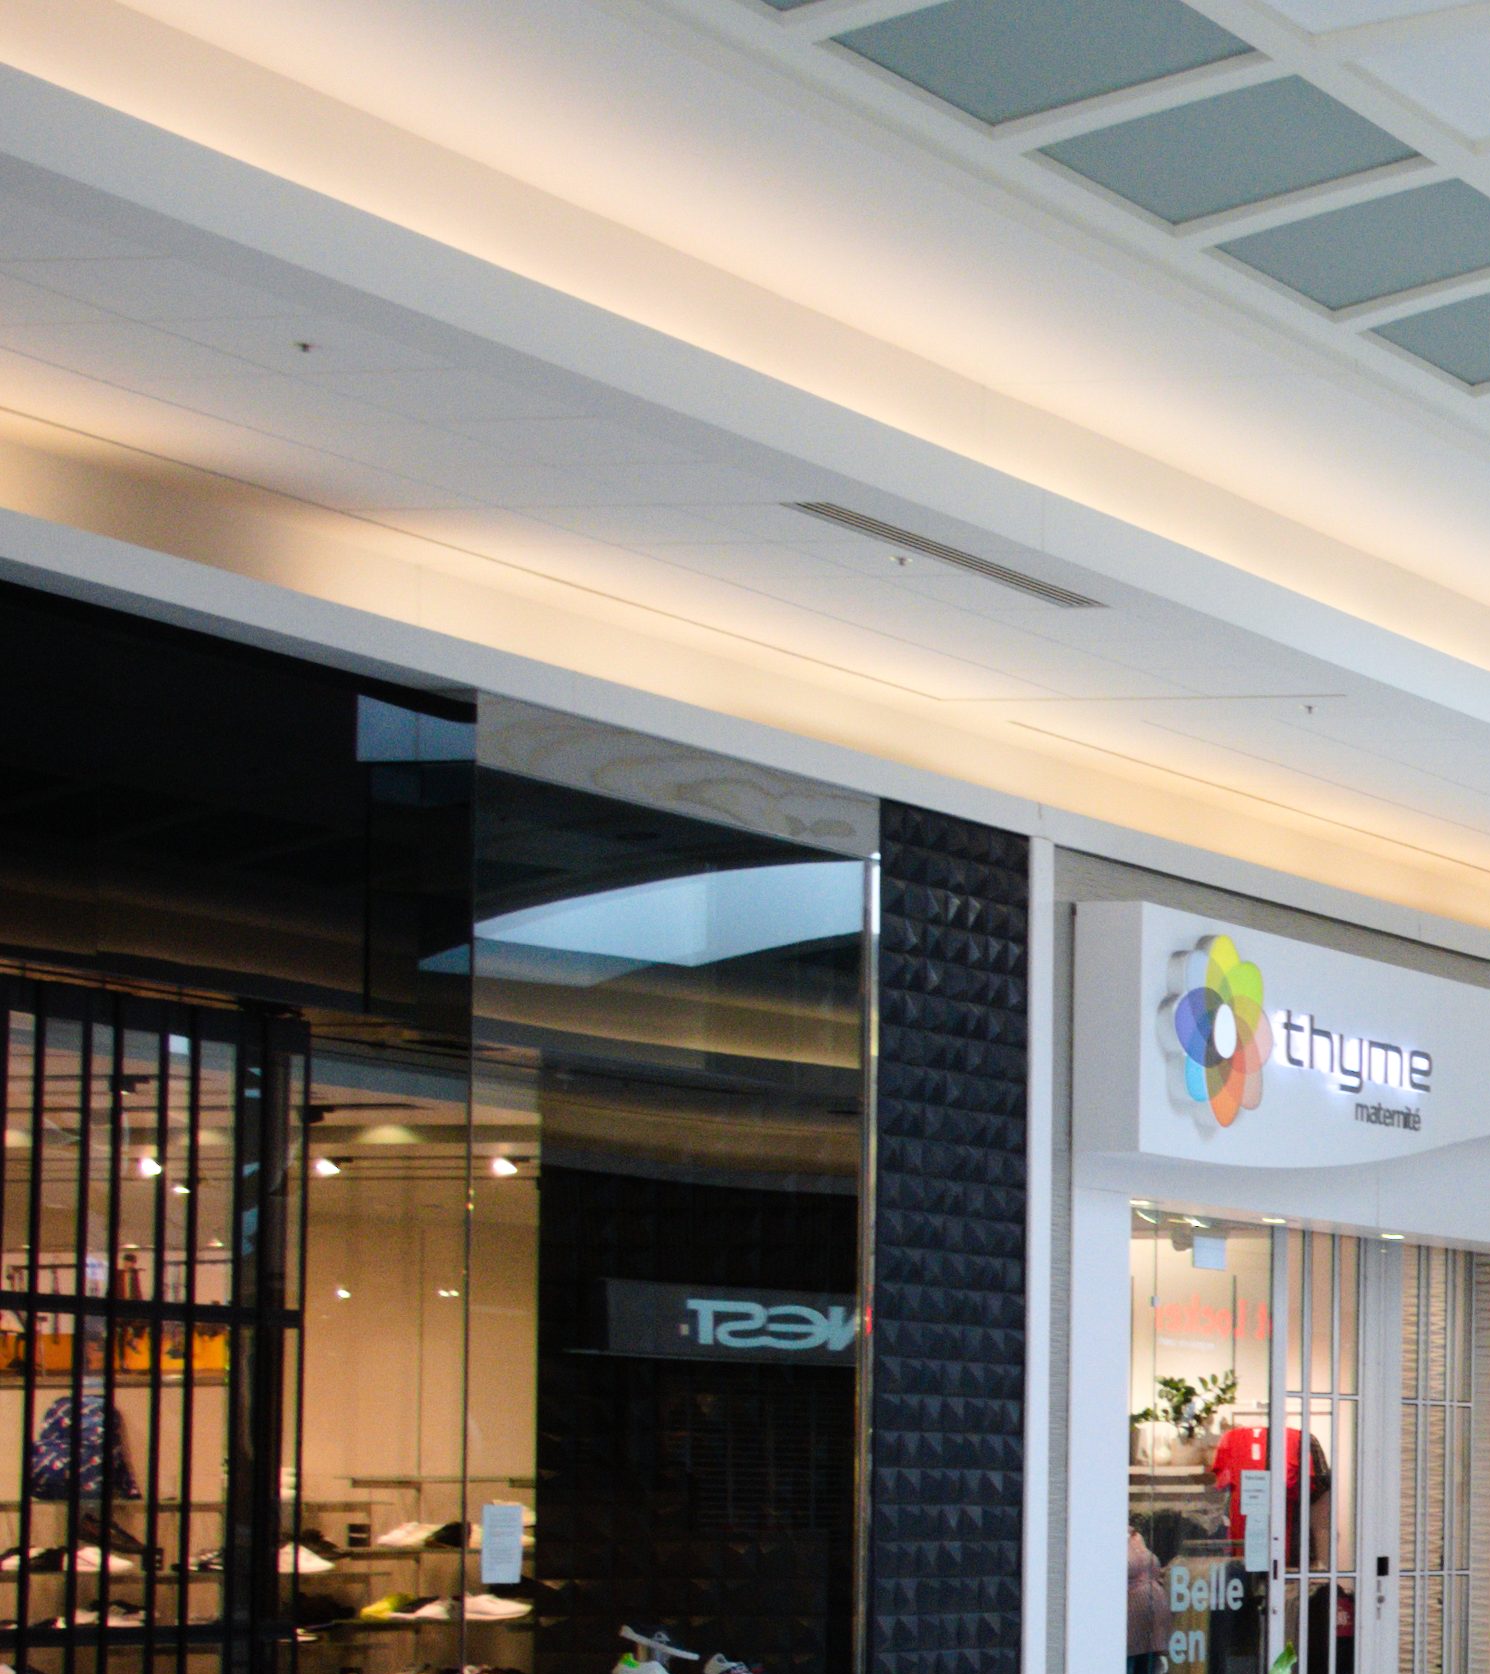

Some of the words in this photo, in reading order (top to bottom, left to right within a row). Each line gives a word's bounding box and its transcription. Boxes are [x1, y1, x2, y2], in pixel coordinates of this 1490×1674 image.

[1283, 1008, 1433, 1095] thyme
[1354, 1102, 1422, 1132] maternité
[1169, 1565, 1244, 1613] Belle
[1168, 1629, 1207, 1665] en
